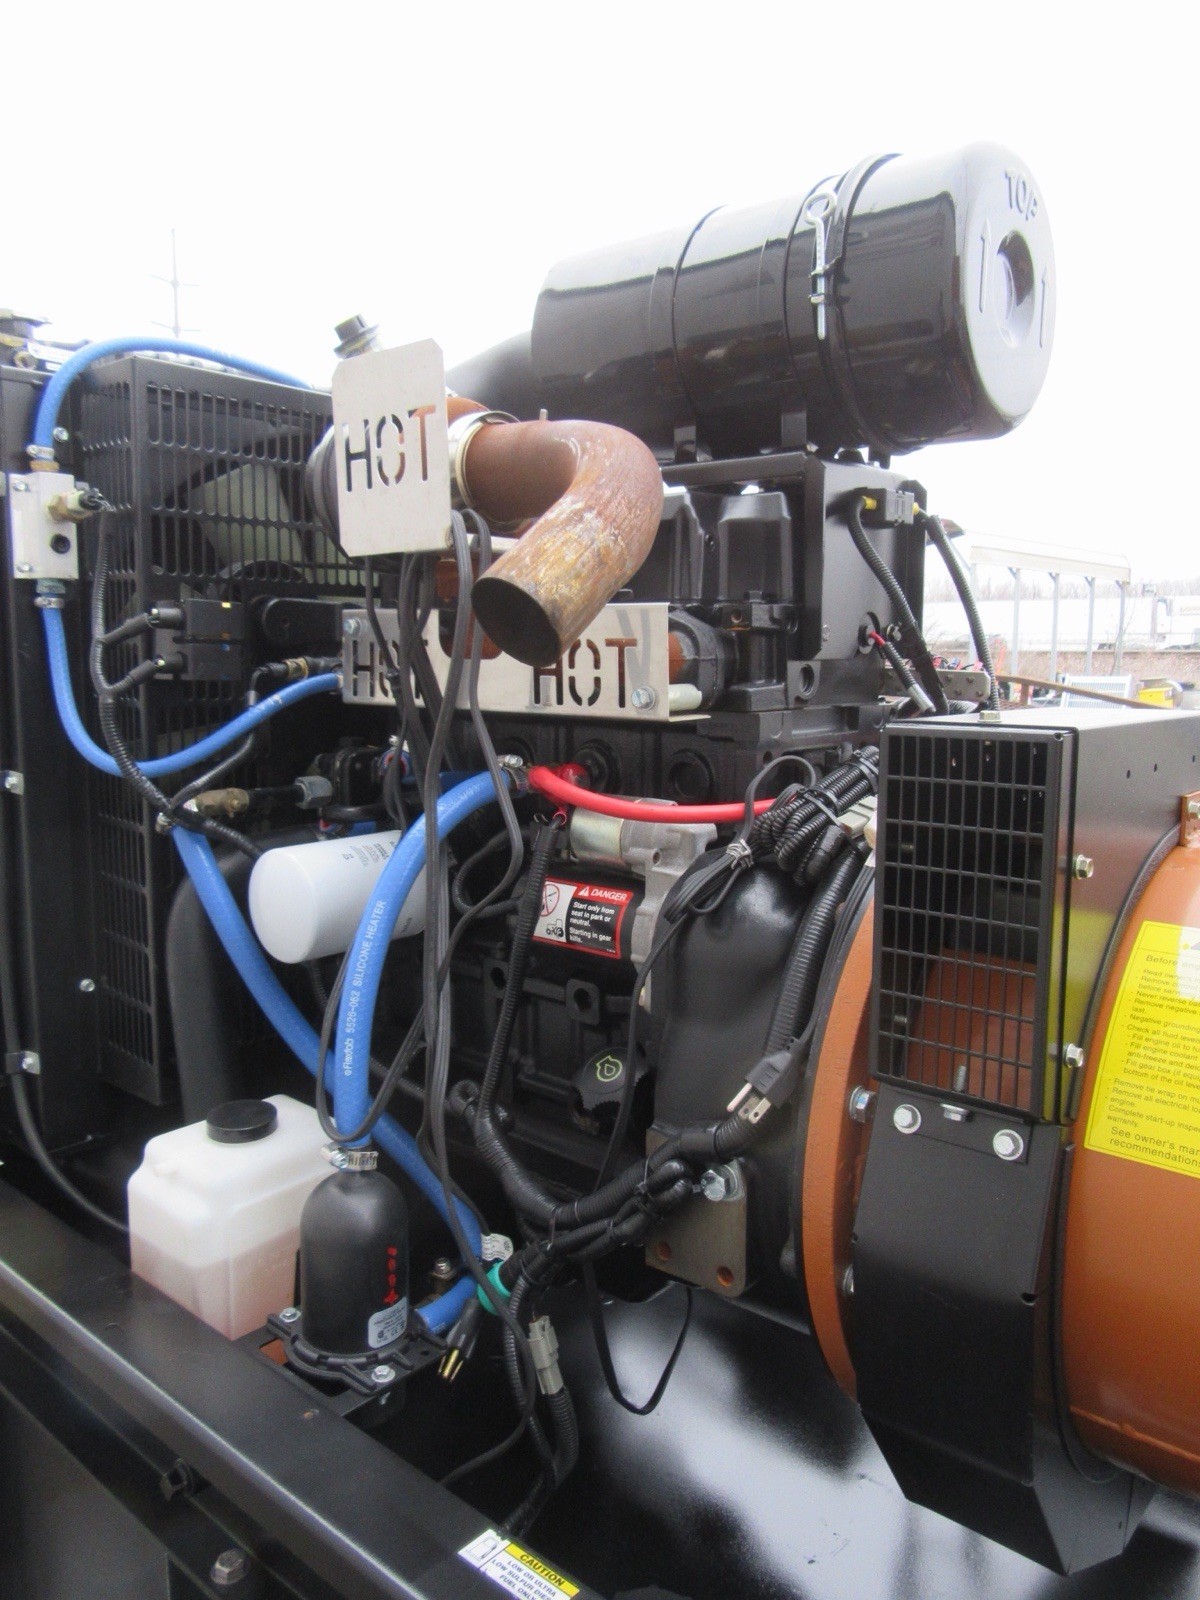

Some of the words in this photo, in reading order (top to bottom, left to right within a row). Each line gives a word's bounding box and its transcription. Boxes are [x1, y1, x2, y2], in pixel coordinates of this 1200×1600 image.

[1004, 168, 1039, 222] TOP
[343, 405, 437, 493] HOT
[533, 637, 638, 708] HOT
[591, 889, 628, 901] DANGER
[588, 905, 600, 913] only
[570, 918, 590, 926] neutral.
[570, 927, 591, 938] Starting
[570, 935, 583, 943] kills.
[353, 941, 372, 986] SILICONE
[365, 901, 387, 939] HEATER
[1146, 955, 1178, 966] Before
[1139, 983, 1161, 992] before
[1141, 976, 1170, 986] Remove
[1136, 991, 1157, 999] Never
[1160, 995, 1186, 1003] reverse
[1135, 998, 1163, 1009] Remove
[1166, 1005, 1197, 1015] negative
[1130, 1014, 1161, 1024] Negative
[1127, 1024, 1149, 1033] Check
[1163, 1031, 1178, 1039] fluid
[1145, 1037, 1169, 1046] engine
[1127, 1051, 1166, 1064] anti-freeze
[1143, 1045, 1168, 1054] engine
[1170, 1051, 1198, 1060] coolant
[1124, 1068, 1149, 1078] bottom
[1157, 1066, 1171, 1074] box
[1114, 1078, 1144, 1090] Remove
[1158, 1090, 1176, 1098] wrap
[1110, 1097, 1137, 1108] engine.
[1112, 1087, 1142, 1099] Remove
[1155, 1097, 1190, 1111] electrical
[1107, 1115, 1140, 1128] warranty.
[1109, 1105, 1143, 1118] Complete
[1146, 1115, 1175, 1127] start-up
[1111, 1126, 1131, 1138] See
[1134, 1134, 1175, 1149] owner's
[492, 1559, 508, 1571] LOW
[508, 1570, 534, 1590] SULFUR
[520, 1554, 566, 1587] CAUTION
[500, 1574, 516, 1589] FUEL
[508, 1560, 523, 1573] LOW
[524, 1571, 534, 1581] OR
[534, 1579, 556, 1597] ULTRA
